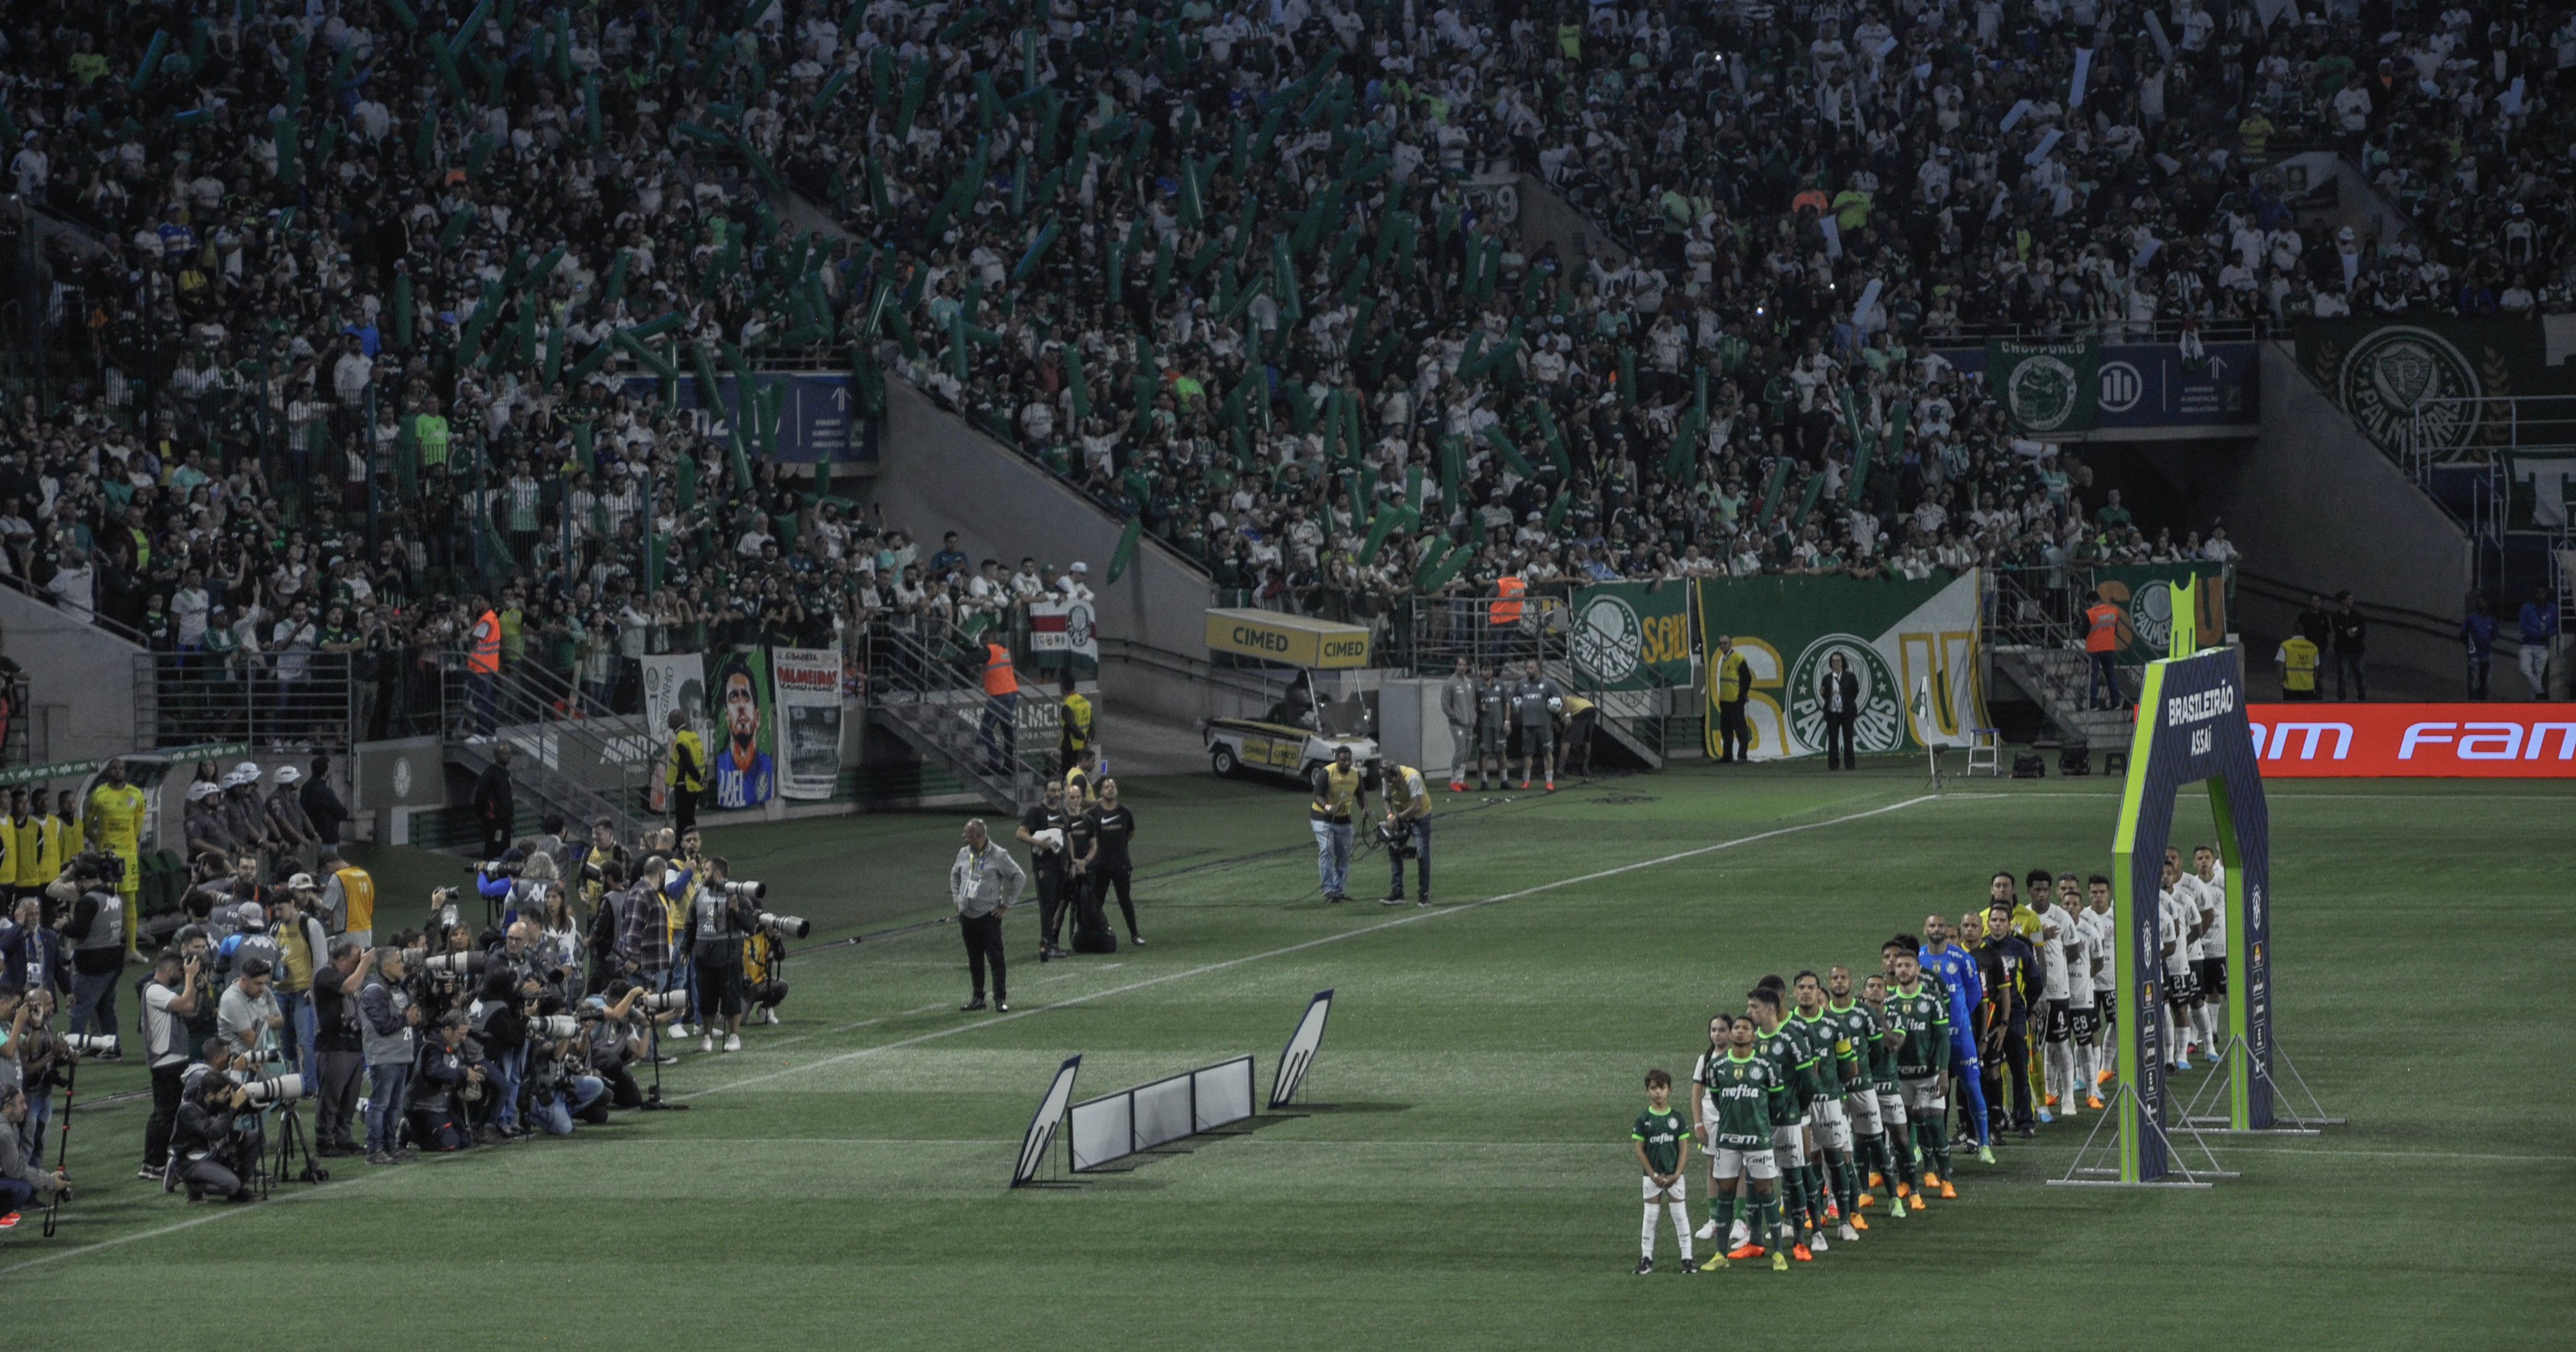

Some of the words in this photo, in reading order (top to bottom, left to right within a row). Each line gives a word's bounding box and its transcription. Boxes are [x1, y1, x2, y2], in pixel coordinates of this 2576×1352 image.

[1233, 626, 1288, 652] CIMED
[1642, 613, 1688, 664] SOU
[1324, 641, 1364, 657] CIMED
[2169, 678, 2234, 727] BRASILEIRÃO
[717, 769, 746, 808] ABEL
[2174, 975, 2187, 990] 21
[2073, 1014, 2088, 1031] 28
[1721, 1084, 1759, 1100] crefisa
[1650, 1133, 1674, 1144] crefisa
